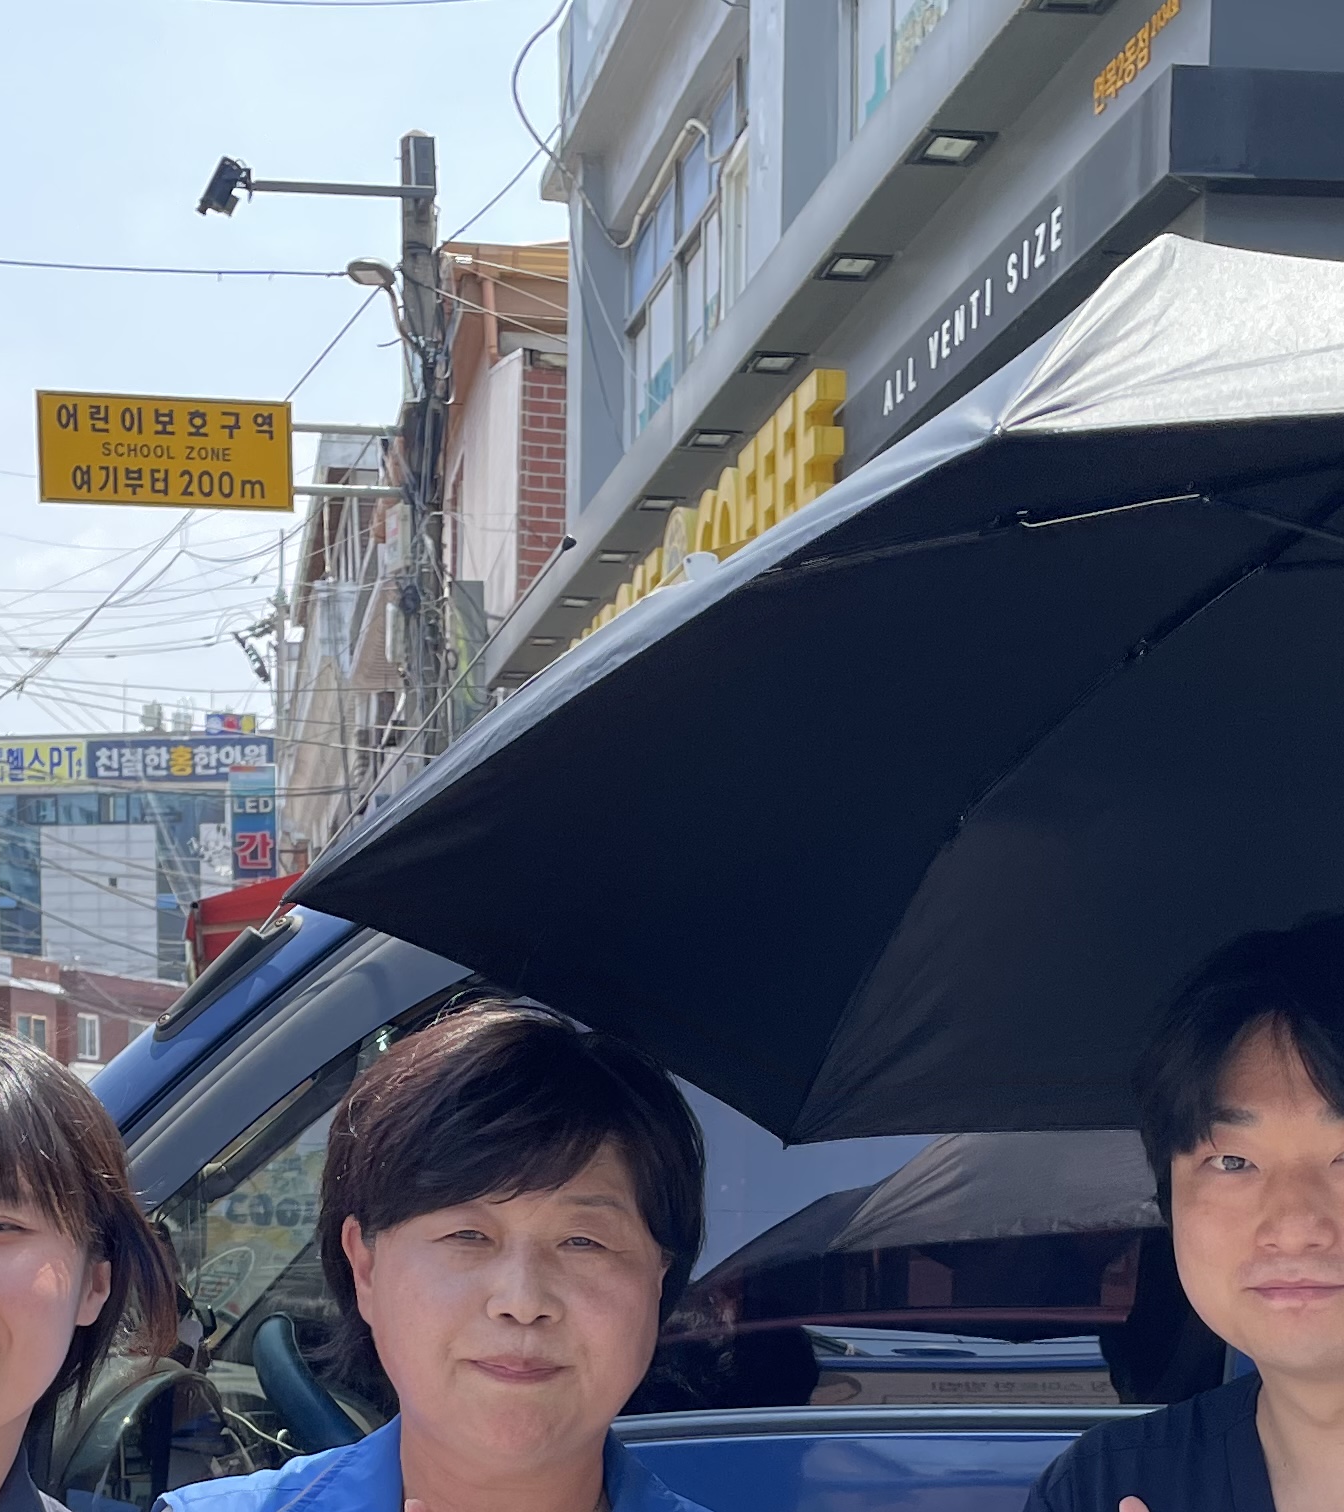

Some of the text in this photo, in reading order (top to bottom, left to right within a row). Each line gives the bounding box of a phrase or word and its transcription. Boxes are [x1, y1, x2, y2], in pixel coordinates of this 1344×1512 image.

[883, 205, 1063, 416] ALL VENTI SIZE
[56, 403, 275, 441] 어린이보호구역
[101, 441, 232, 462] SCHOOL ZONE
[696, 369, 846, 552] COFFEE
[71, 465, 266, 500] 여기부터 200m
[233, 797, 273, 813] LED
[234, 831, 273, 882] 간
